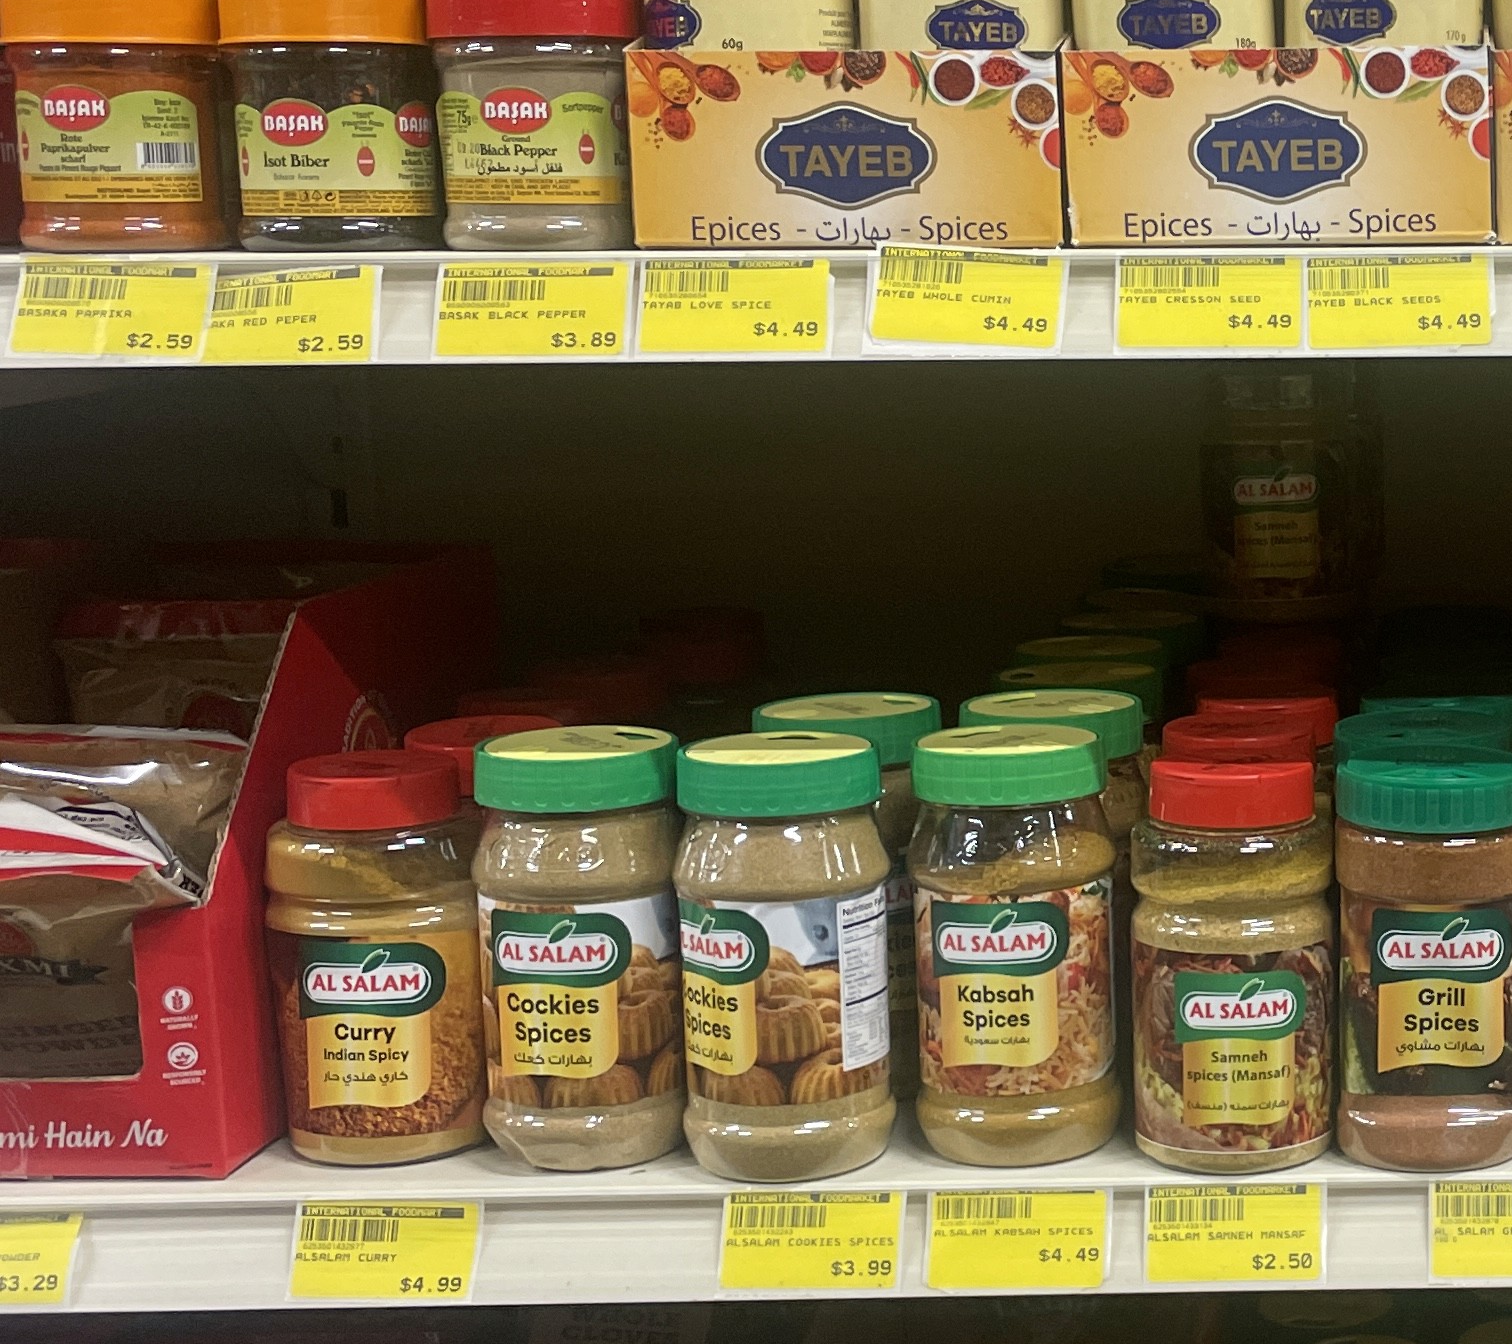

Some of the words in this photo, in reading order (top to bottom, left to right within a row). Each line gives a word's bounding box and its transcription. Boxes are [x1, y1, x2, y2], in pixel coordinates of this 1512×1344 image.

[1310, 7, 1382, 29] TAYEB
[938, 21, 1018, 44] TAYEB
[291, 154, 330, 168] Biber
[480, 143, 513, 156] Black
[516, 143, 558, 159] Pepper
[779, 144, 915, 178] TAYEB
[691, 216, 781, 244] Epices
[814, 217, 892, 243] بهارات
[918, 215, 1009, 244] Spices
[875, 288, 916, 299] TAYEB
[922, 292, 963, 303] WHOLE
[970, 295, 1011, 305] CUMIN
[439, 311, 484, 322] BASAK
[488, 311, 532, 321] BLACK
[536, 310, 587, 320] PEPPER
[982, 315, 1048, 334] $4.49
[1228, 314, 1292, 330] $4.49
[753, 320, 820, 338] $4.49
[127, 333, 193, 350] $2.59
[551, 331, 617, 348] $3.89
[1387, 942, 1415, 959] AL
[1420, 941, 1495, 960] SALAM
[311, 973, 338, 992] AL
[343, 973, 420, 993] SALAM
[507, 993, 600, 1015] Cockies
[1417, 987, 1466, 1007] Grill
[334, 1023, 396, 1045] Curry
[1403, 1013, 1480, 1035] Spices
[514, 1022, 591, 1047] Spices
[323, 1048, 365, 1062] Indian
[368, 1047, 410, 1064] Spicy
[1211, 1050, 1268, 1063] Samneh
[1186, 1068, 1230, 1084] spices
[1231, 1064, 1292, 1083] (Mansaf)
[44, 1121, 116, 1149] Hain
[122, 1119, 169, 1148] Na
[830, 1259, 893, 1279] $3.99
[1251, 1253, 1313, 1273] $2.50
[400, 1275, 463, 1296] $4.99
